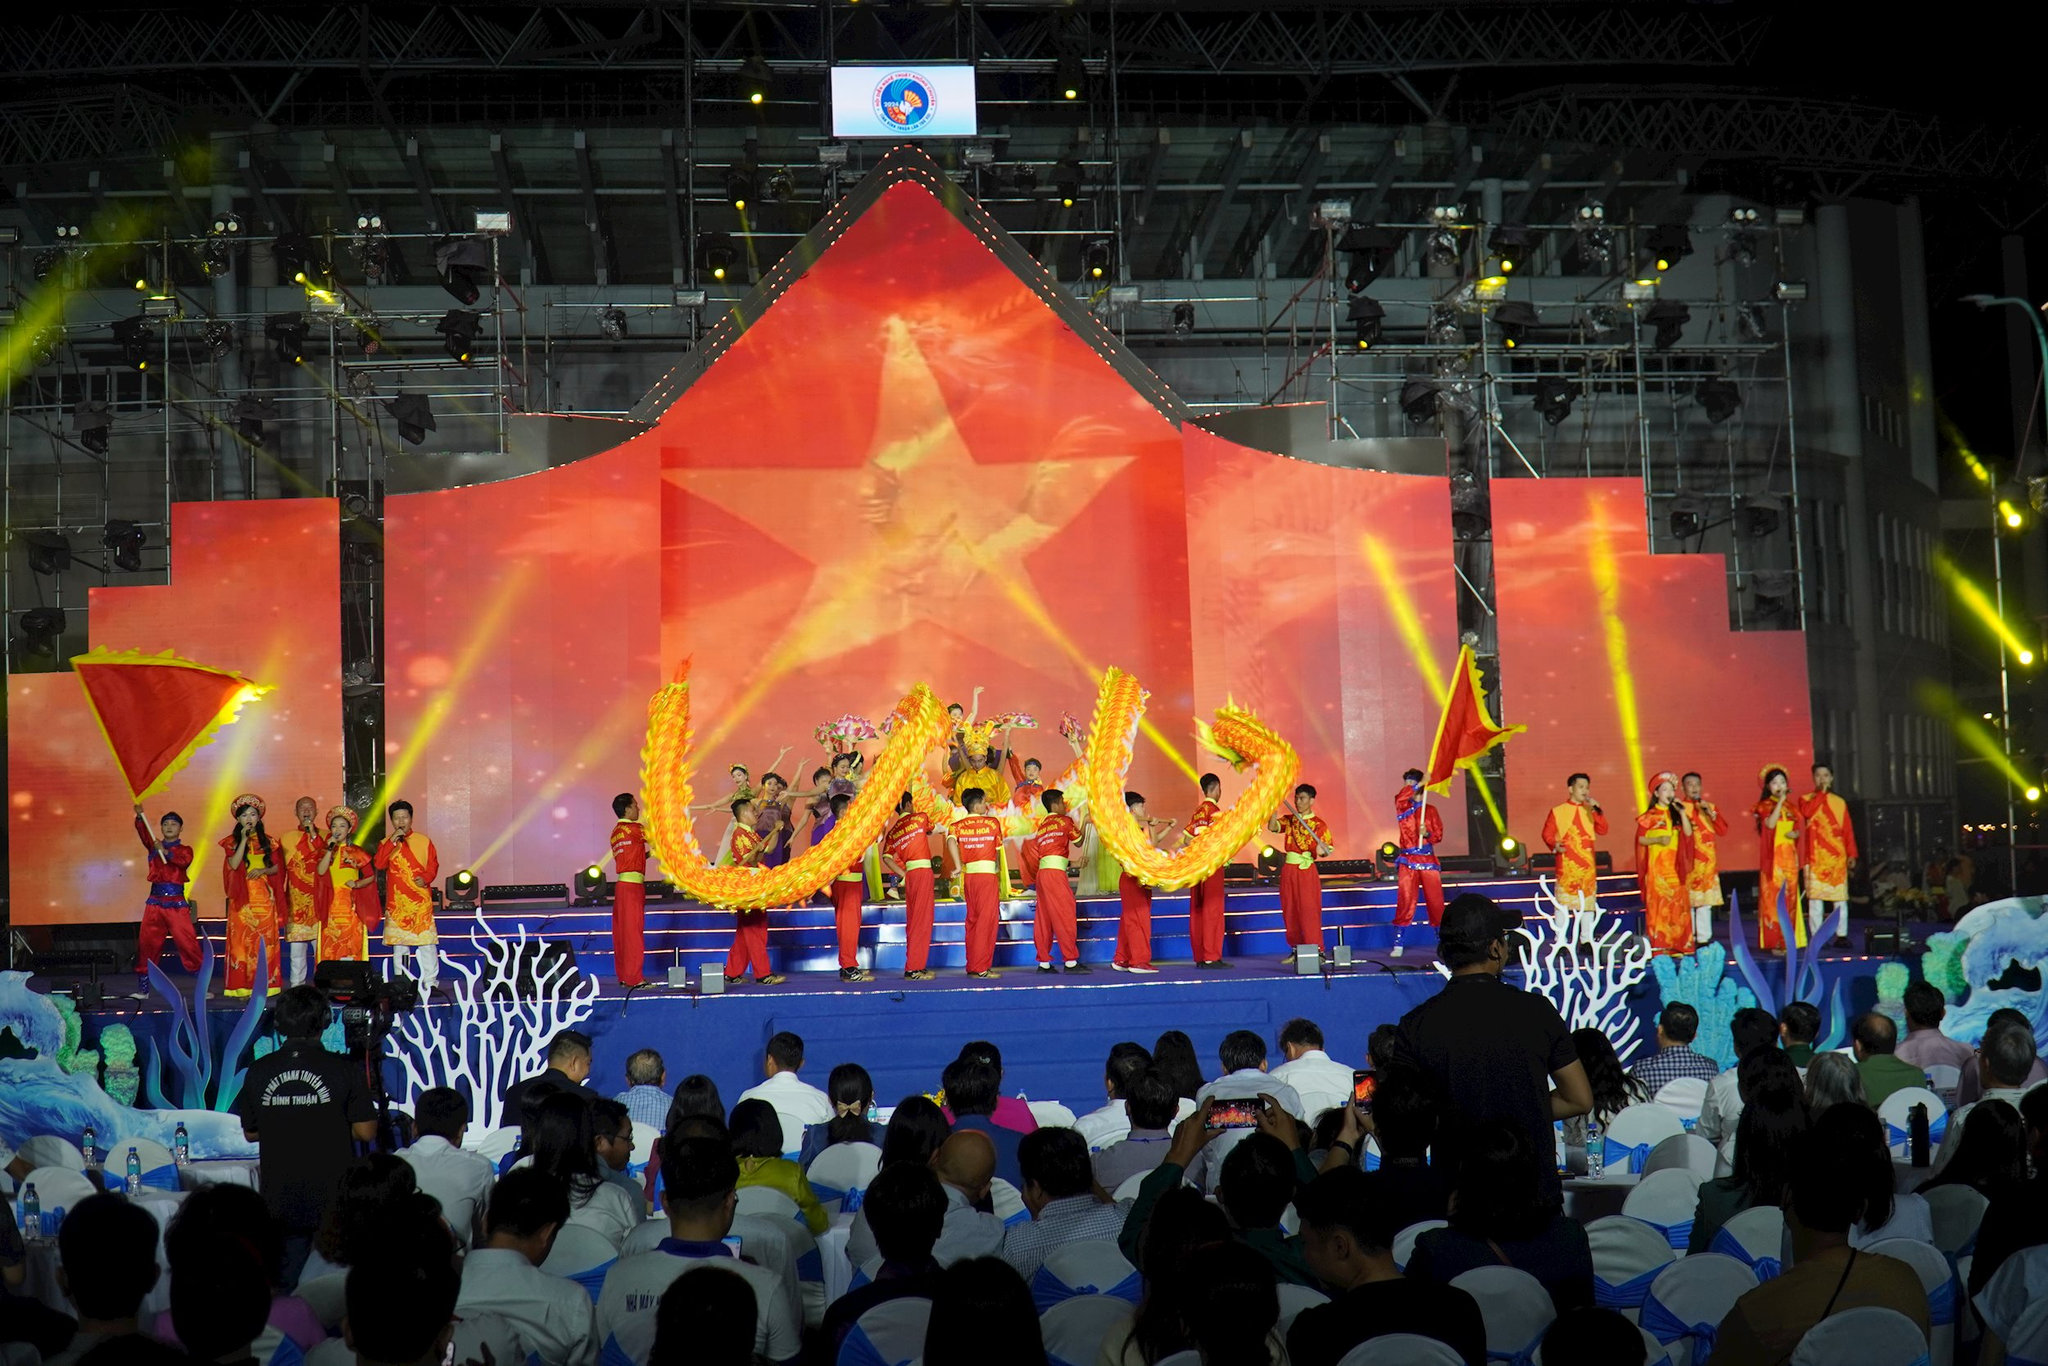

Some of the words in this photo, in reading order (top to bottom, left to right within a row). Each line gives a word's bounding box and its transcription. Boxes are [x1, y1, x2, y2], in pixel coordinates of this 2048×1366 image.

[976, 827, 990, 835] HOA
[265, 1076, 280, 1095] PHÁT
[278, 1069, 300, 1084] THANH
[292, 1093, 318, 1107] THUẬN
